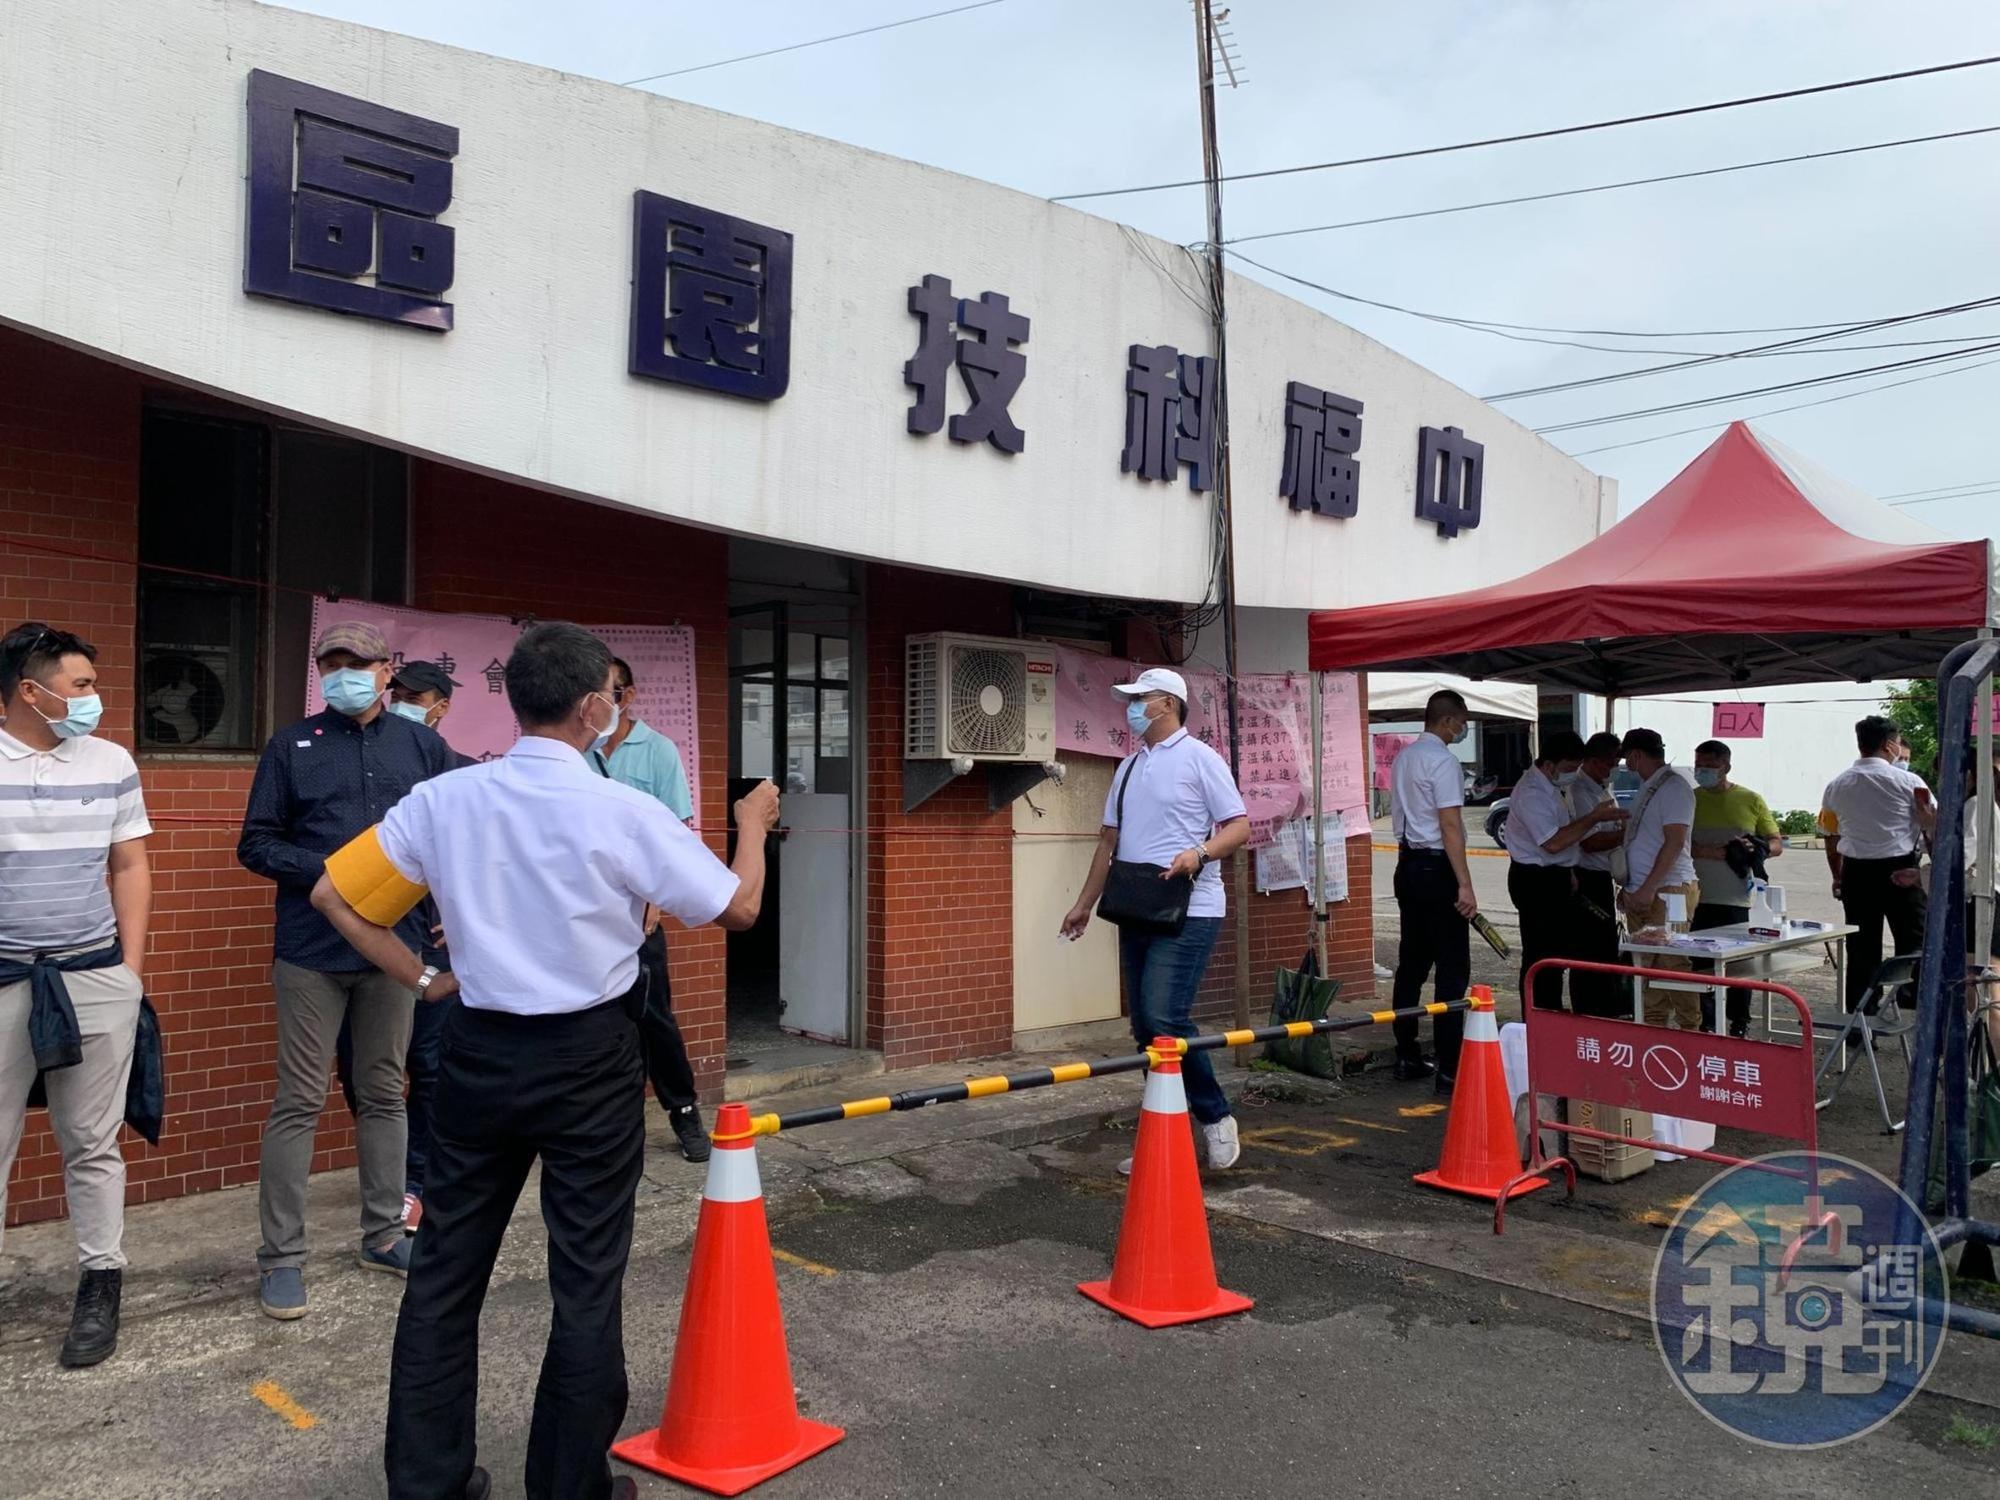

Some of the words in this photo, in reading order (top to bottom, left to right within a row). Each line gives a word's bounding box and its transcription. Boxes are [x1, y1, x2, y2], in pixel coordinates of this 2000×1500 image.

[1074, 719, 1128, 748] 採訪
[1576, 1036, 1634, 1069] 請勿
[1697, 1053, 1762, 1088] 停車
[1699, 1084, 1763, 1110] 謝謝合作
